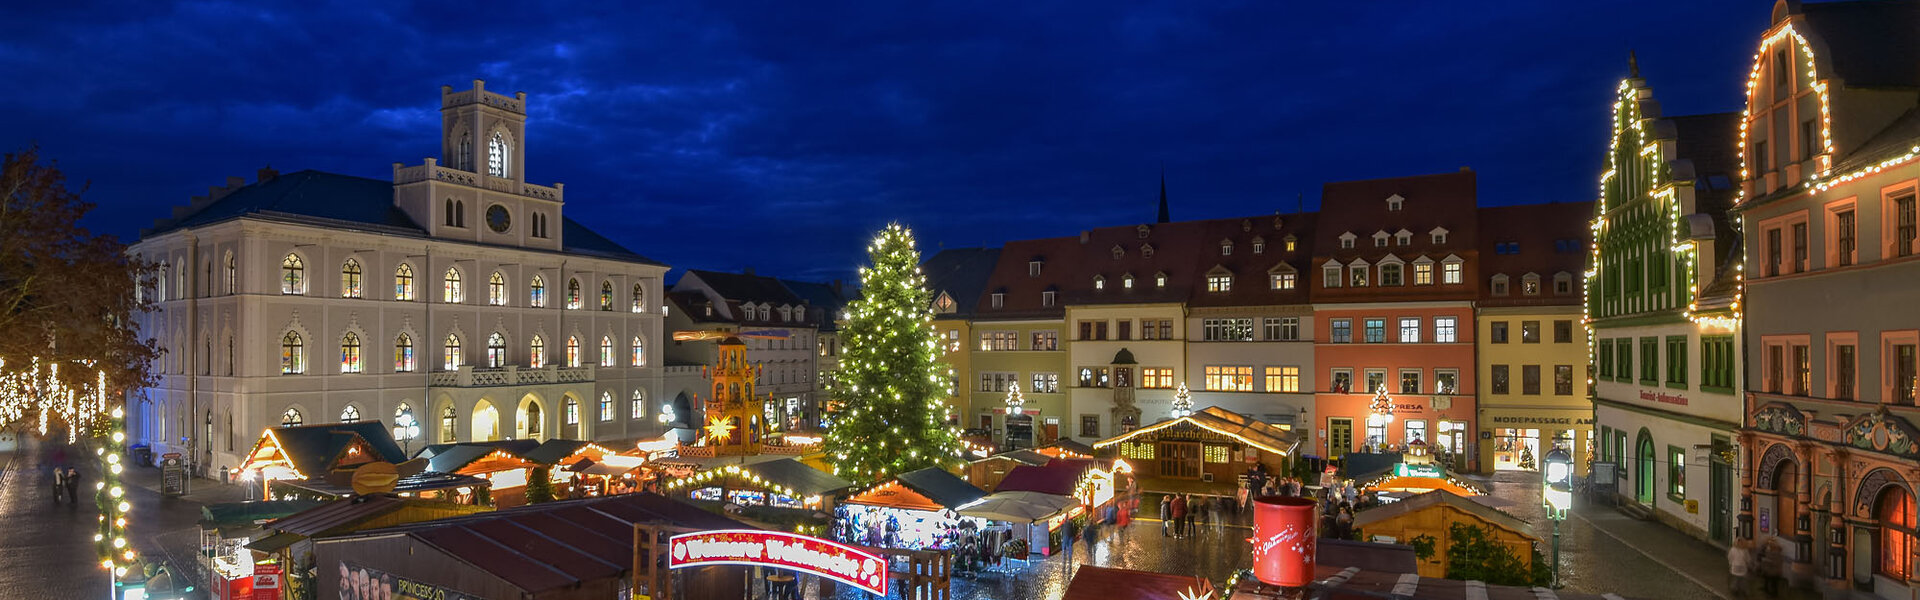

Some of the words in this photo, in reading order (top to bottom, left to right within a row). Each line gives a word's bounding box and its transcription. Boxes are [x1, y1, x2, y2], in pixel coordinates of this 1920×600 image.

[1493, 416, 1571, 425] MODEPASSAGE
[686, 537, 764, 560] Weimarer
[398, 579, 433, 600] PRINCESS
